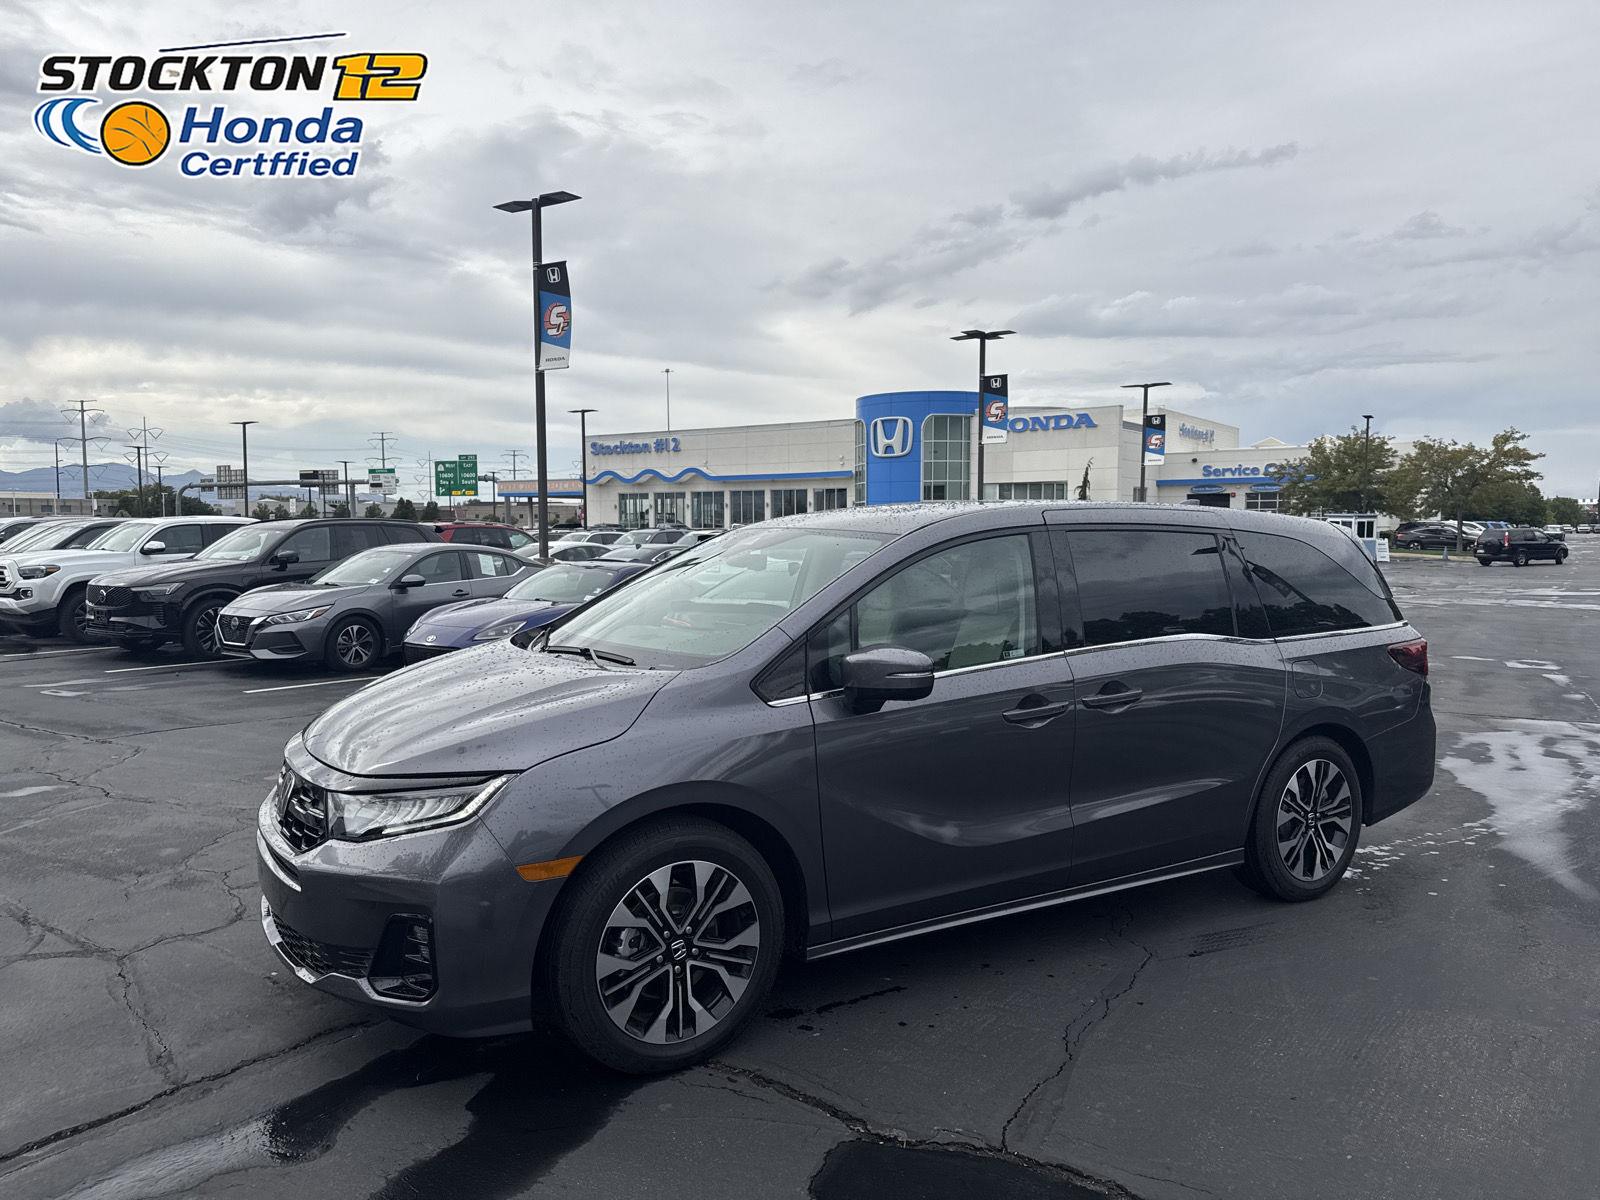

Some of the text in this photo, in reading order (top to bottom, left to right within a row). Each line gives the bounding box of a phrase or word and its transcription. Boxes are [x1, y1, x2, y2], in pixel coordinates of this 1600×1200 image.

[1007, 413, 1098, 433] ONDA
[590, 438, 681, 456] Stockton #12
[1202, 464, 1260, 477] Service
